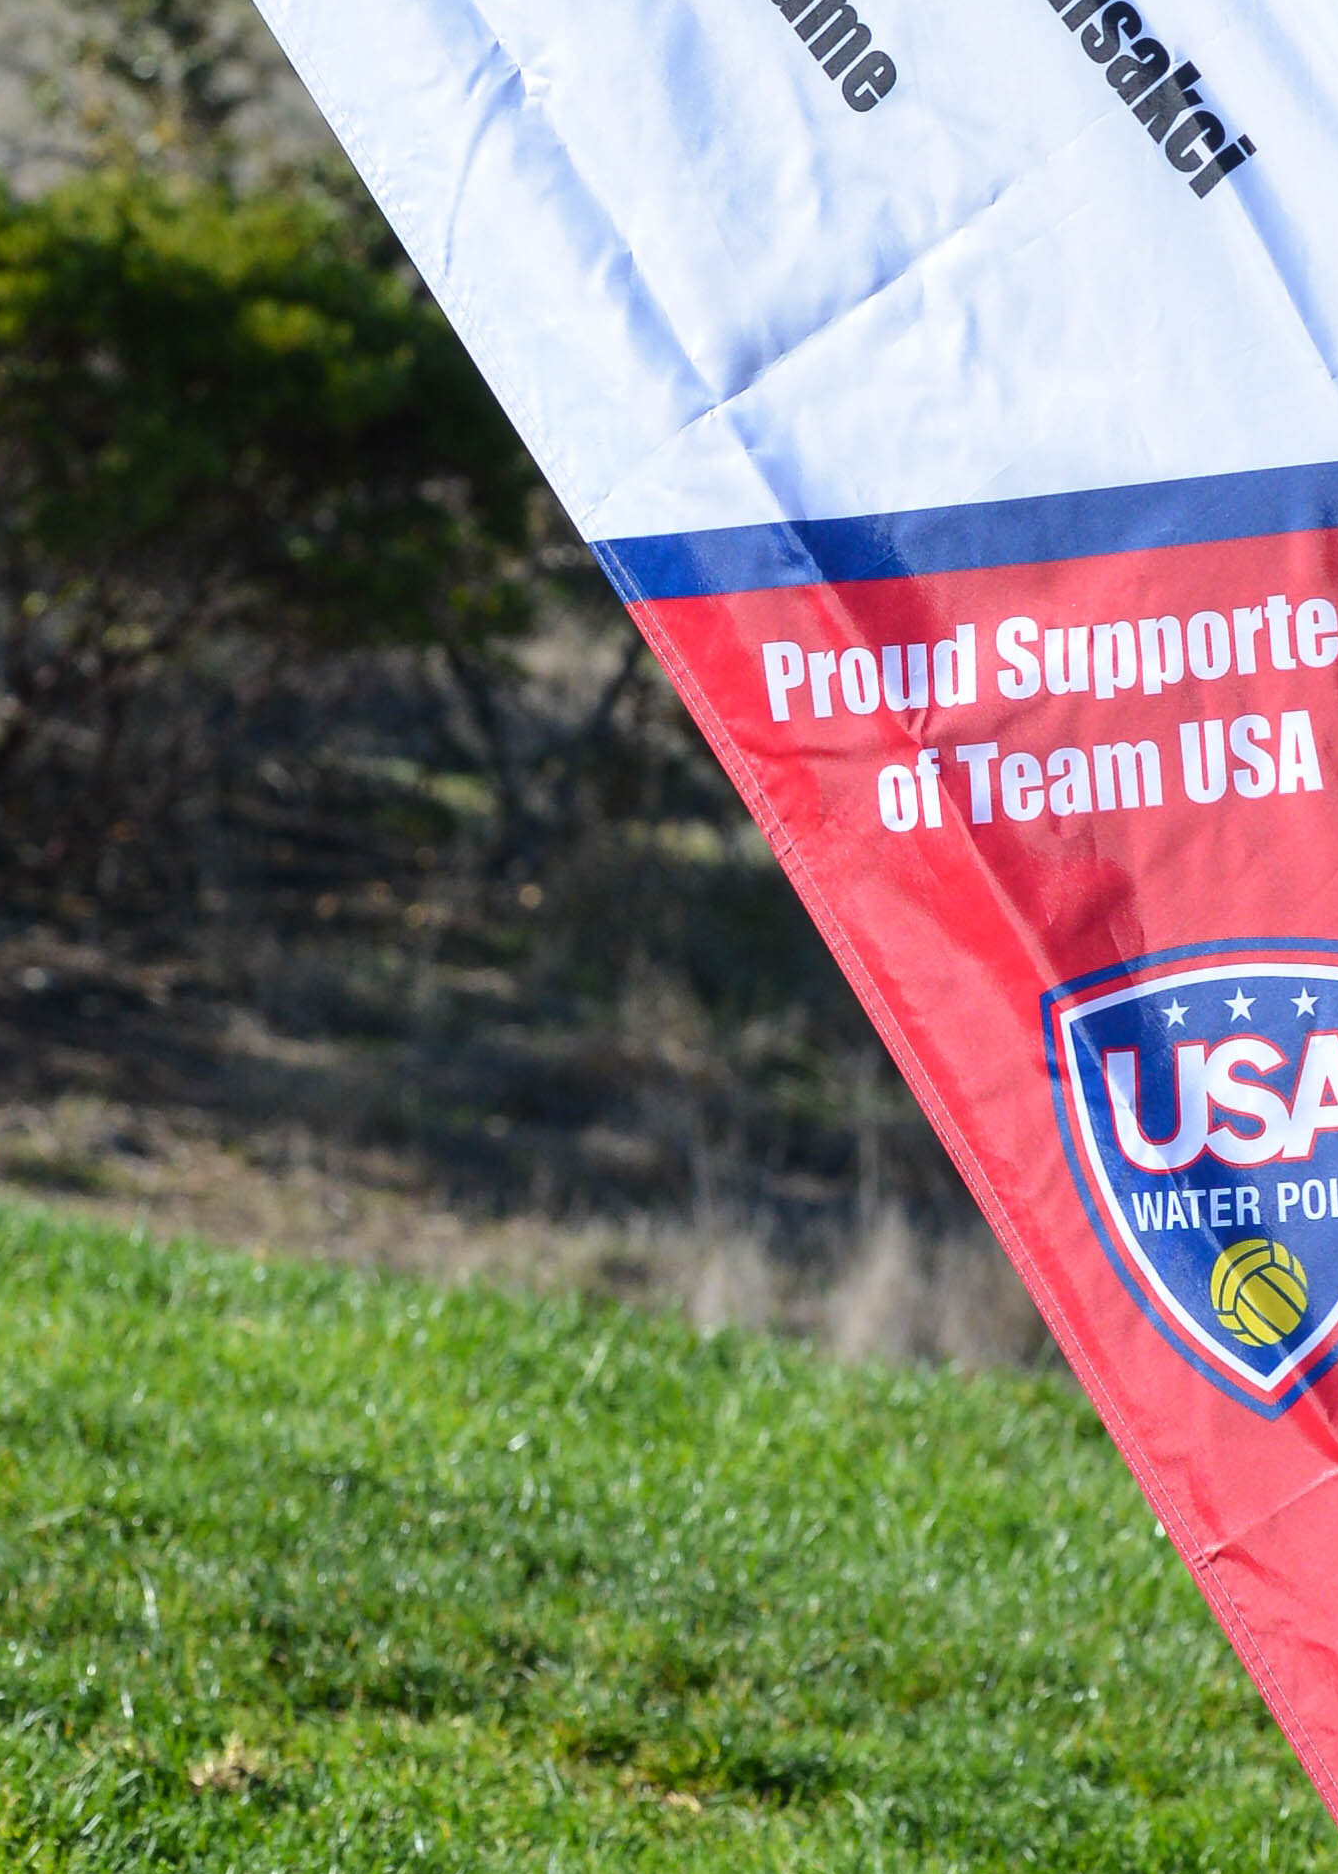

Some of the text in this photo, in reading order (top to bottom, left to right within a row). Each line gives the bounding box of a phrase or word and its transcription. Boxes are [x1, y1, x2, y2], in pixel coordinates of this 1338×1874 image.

[761, 621, 979, 723] Proud
[876, 709, 1325, 834] of Team USA
[1130, 1181, 1263, 1233] WATER
